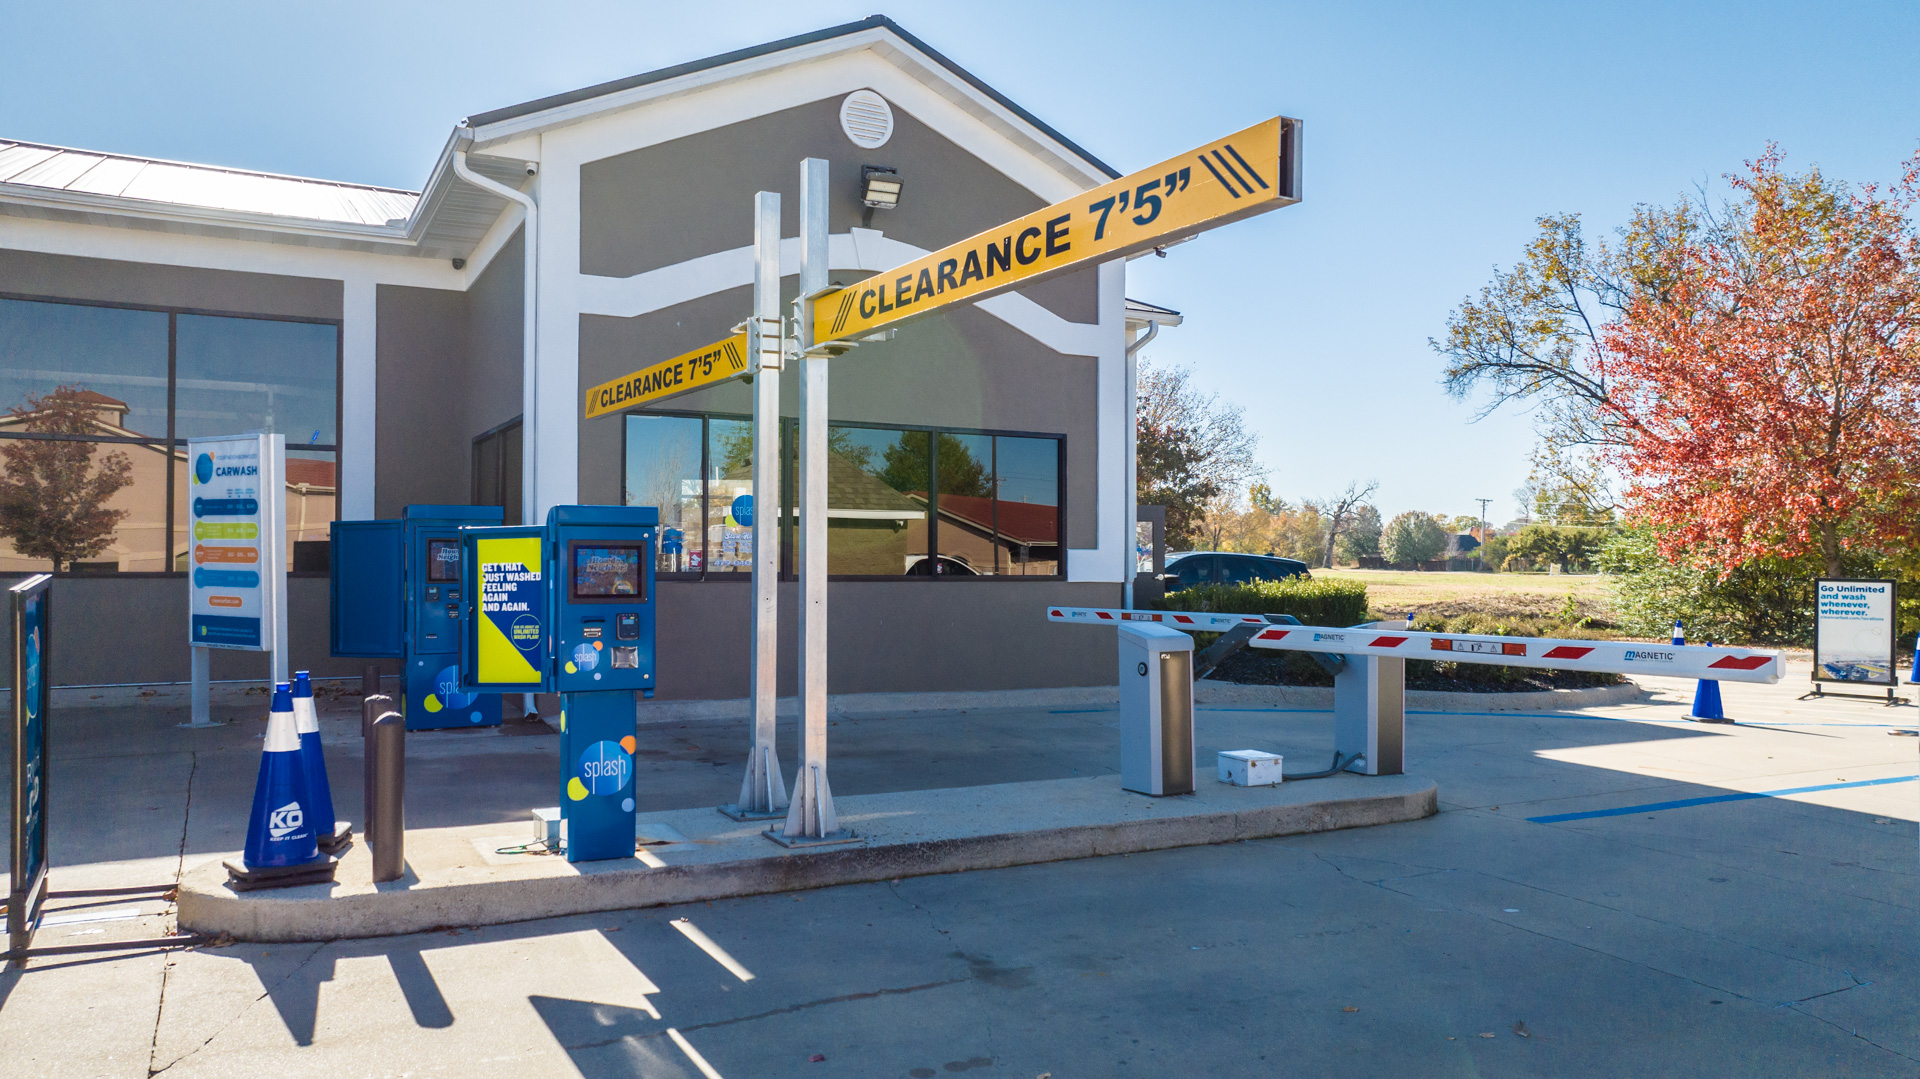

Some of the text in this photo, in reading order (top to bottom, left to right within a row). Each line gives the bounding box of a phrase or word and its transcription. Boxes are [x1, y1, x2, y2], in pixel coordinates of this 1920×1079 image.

[859, 213, 1071, 320] CLEARANCE
[601, 363, 683, 408] CLEARANCE
[215, 465, 258, 477] CARWASH
[482, 562, 523, 572] GET THAT
[482, 572, 541, 582] JUST WASHED
[482, 582, 517, 592] FEELING
[482, 593, 508, 602] AGAIN
[482, 602, 530, 612] AND AGAIN.
[1820, 601, 1870, 609] whenever,
[584, 740, 626, 795] splash
[269, 809, 303, 829] KO
